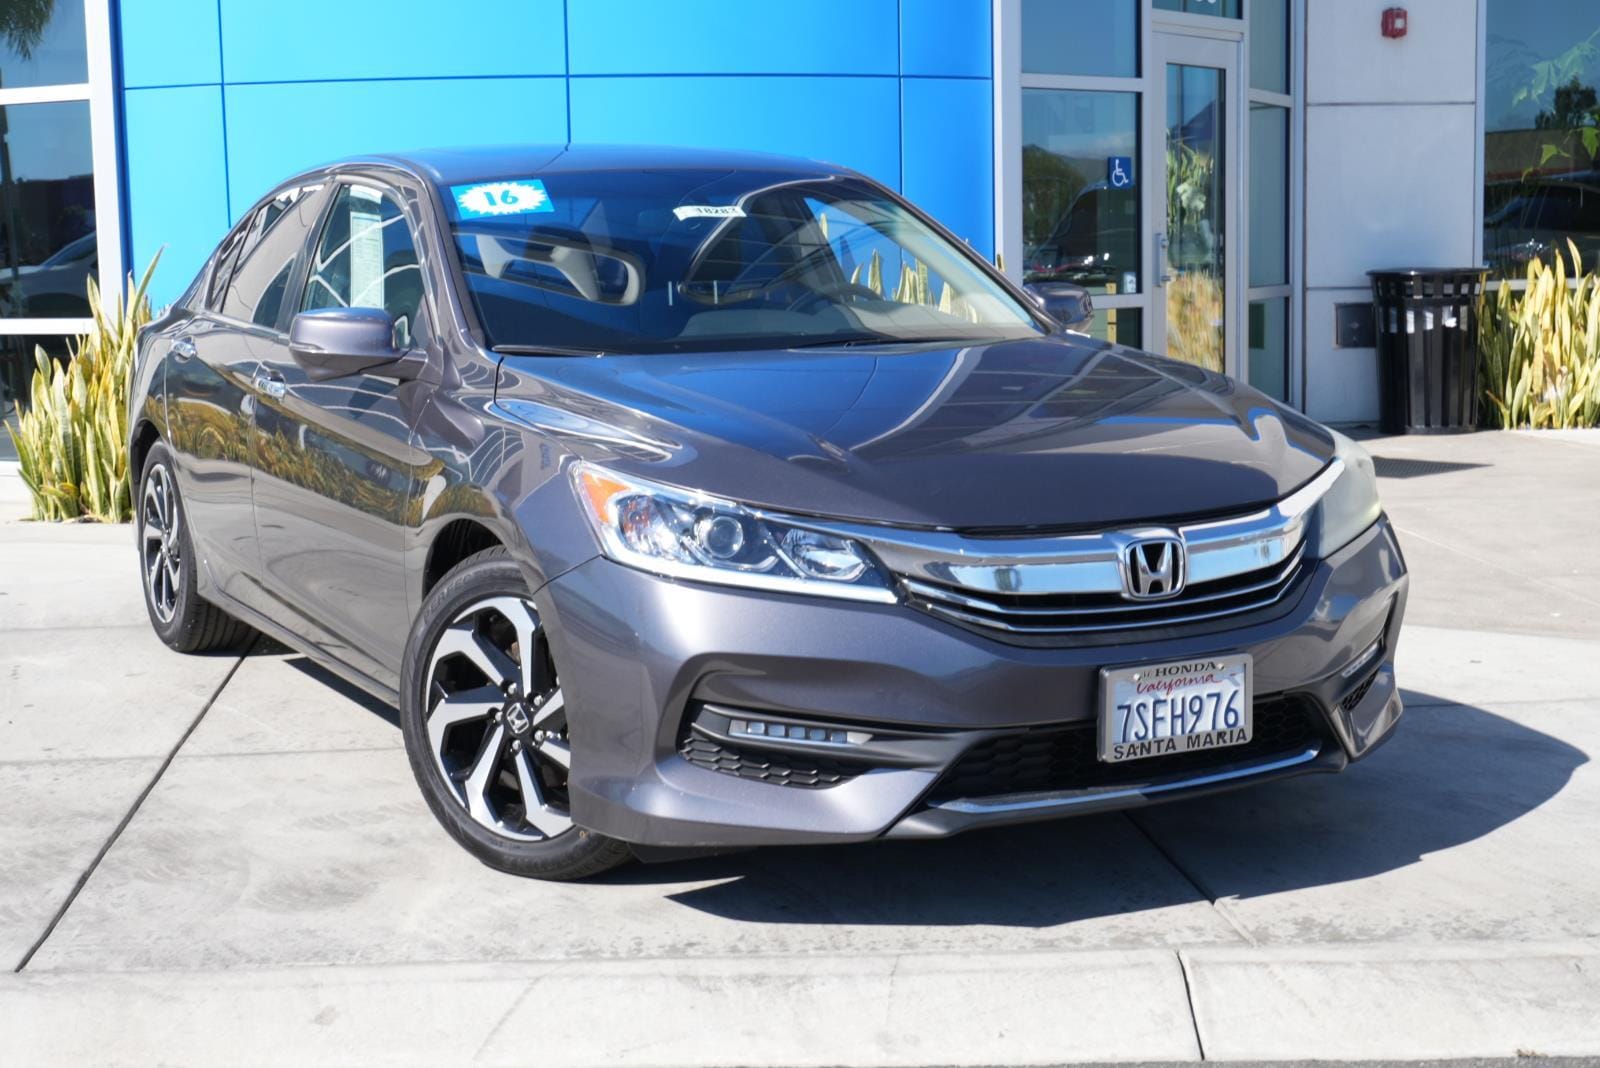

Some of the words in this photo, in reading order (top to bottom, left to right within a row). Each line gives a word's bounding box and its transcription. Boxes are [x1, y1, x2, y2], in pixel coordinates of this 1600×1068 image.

[484, 190, 519, 206] 16
[1155, 661, 1217, 678] HONDA
[1136, 673, 1222, 696] California
[1117, 690, 1239, 743] 7SFH976
[1114, 738, 1177, 760] SANTA
[1186, 728, 1248, 750] MARIA
